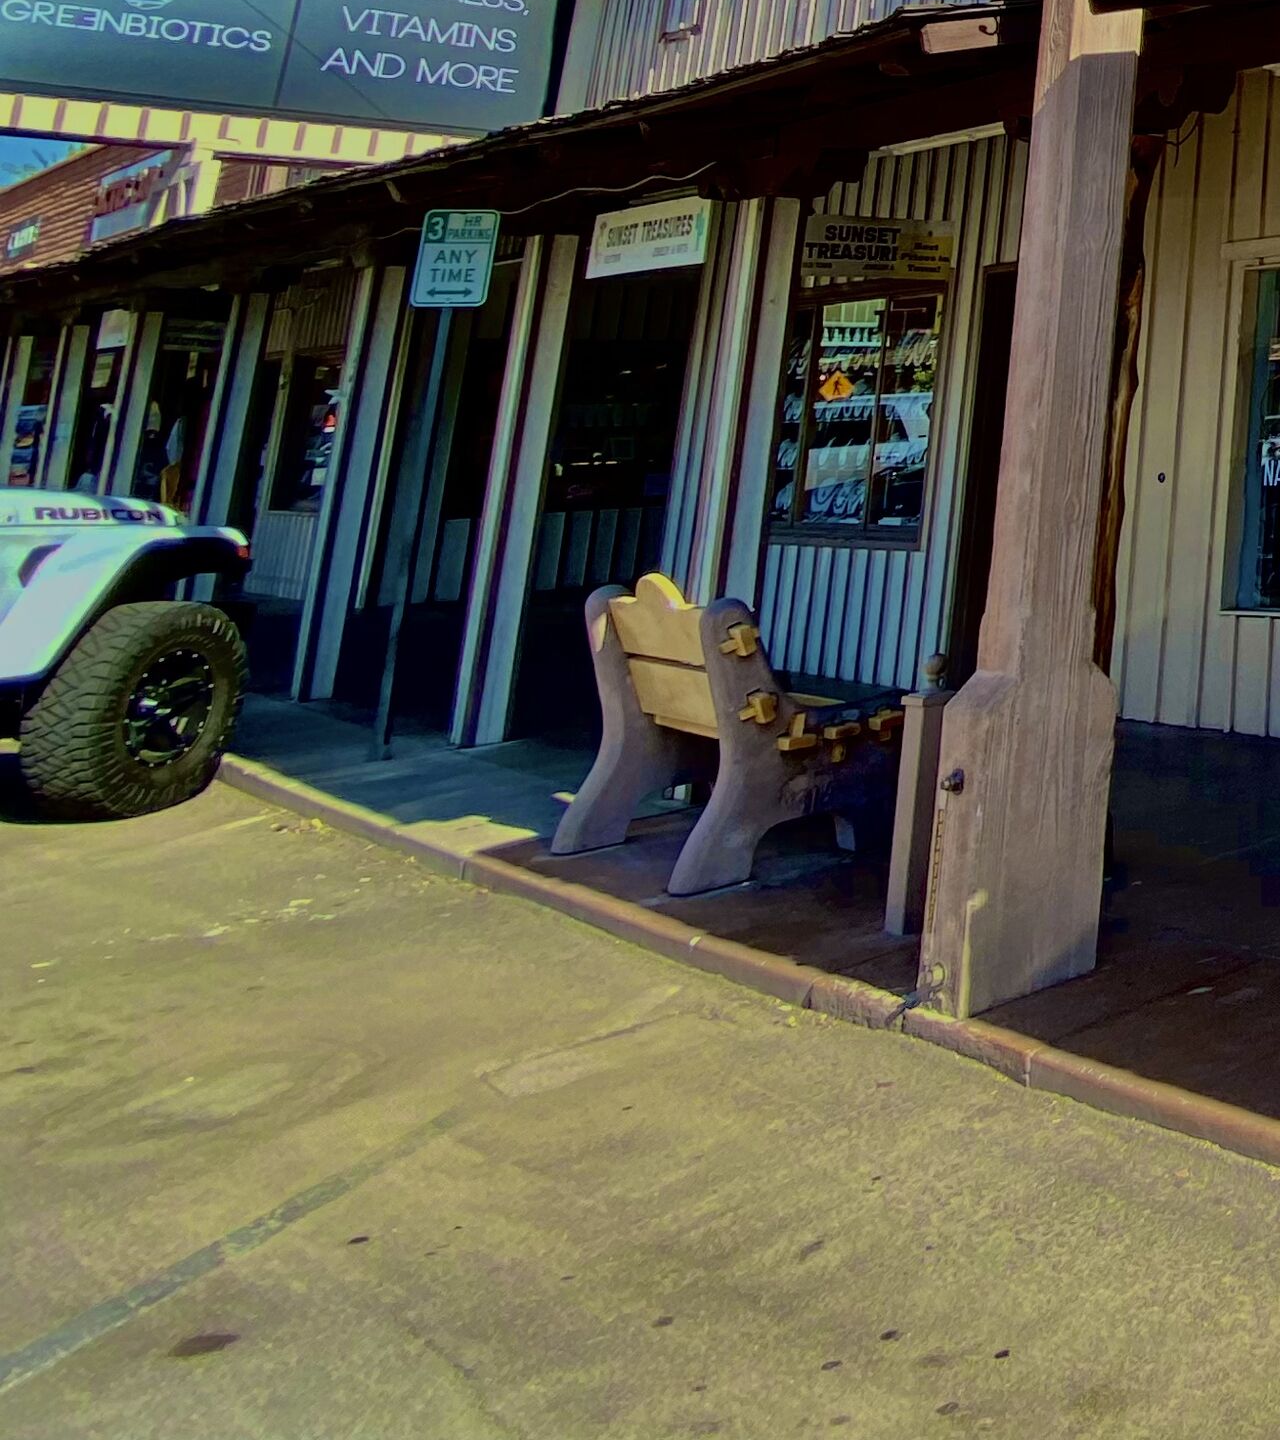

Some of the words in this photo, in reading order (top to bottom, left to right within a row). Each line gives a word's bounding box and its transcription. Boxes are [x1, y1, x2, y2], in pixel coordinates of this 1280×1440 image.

[342, 5, 517, 53] VITAMINS
[320, 47, 405, 78] AND
[416, 61, 520, 93] MORE
[428, 217, 444, 240] 3
[825, 225, 901, 244] SUNSET
[433, 250, 477, 264] ANY
[805, 242, 898, 261] TREASUR
[430, 268, 476, 283] TIME
[33, 507, 165, 522] RUBICON
